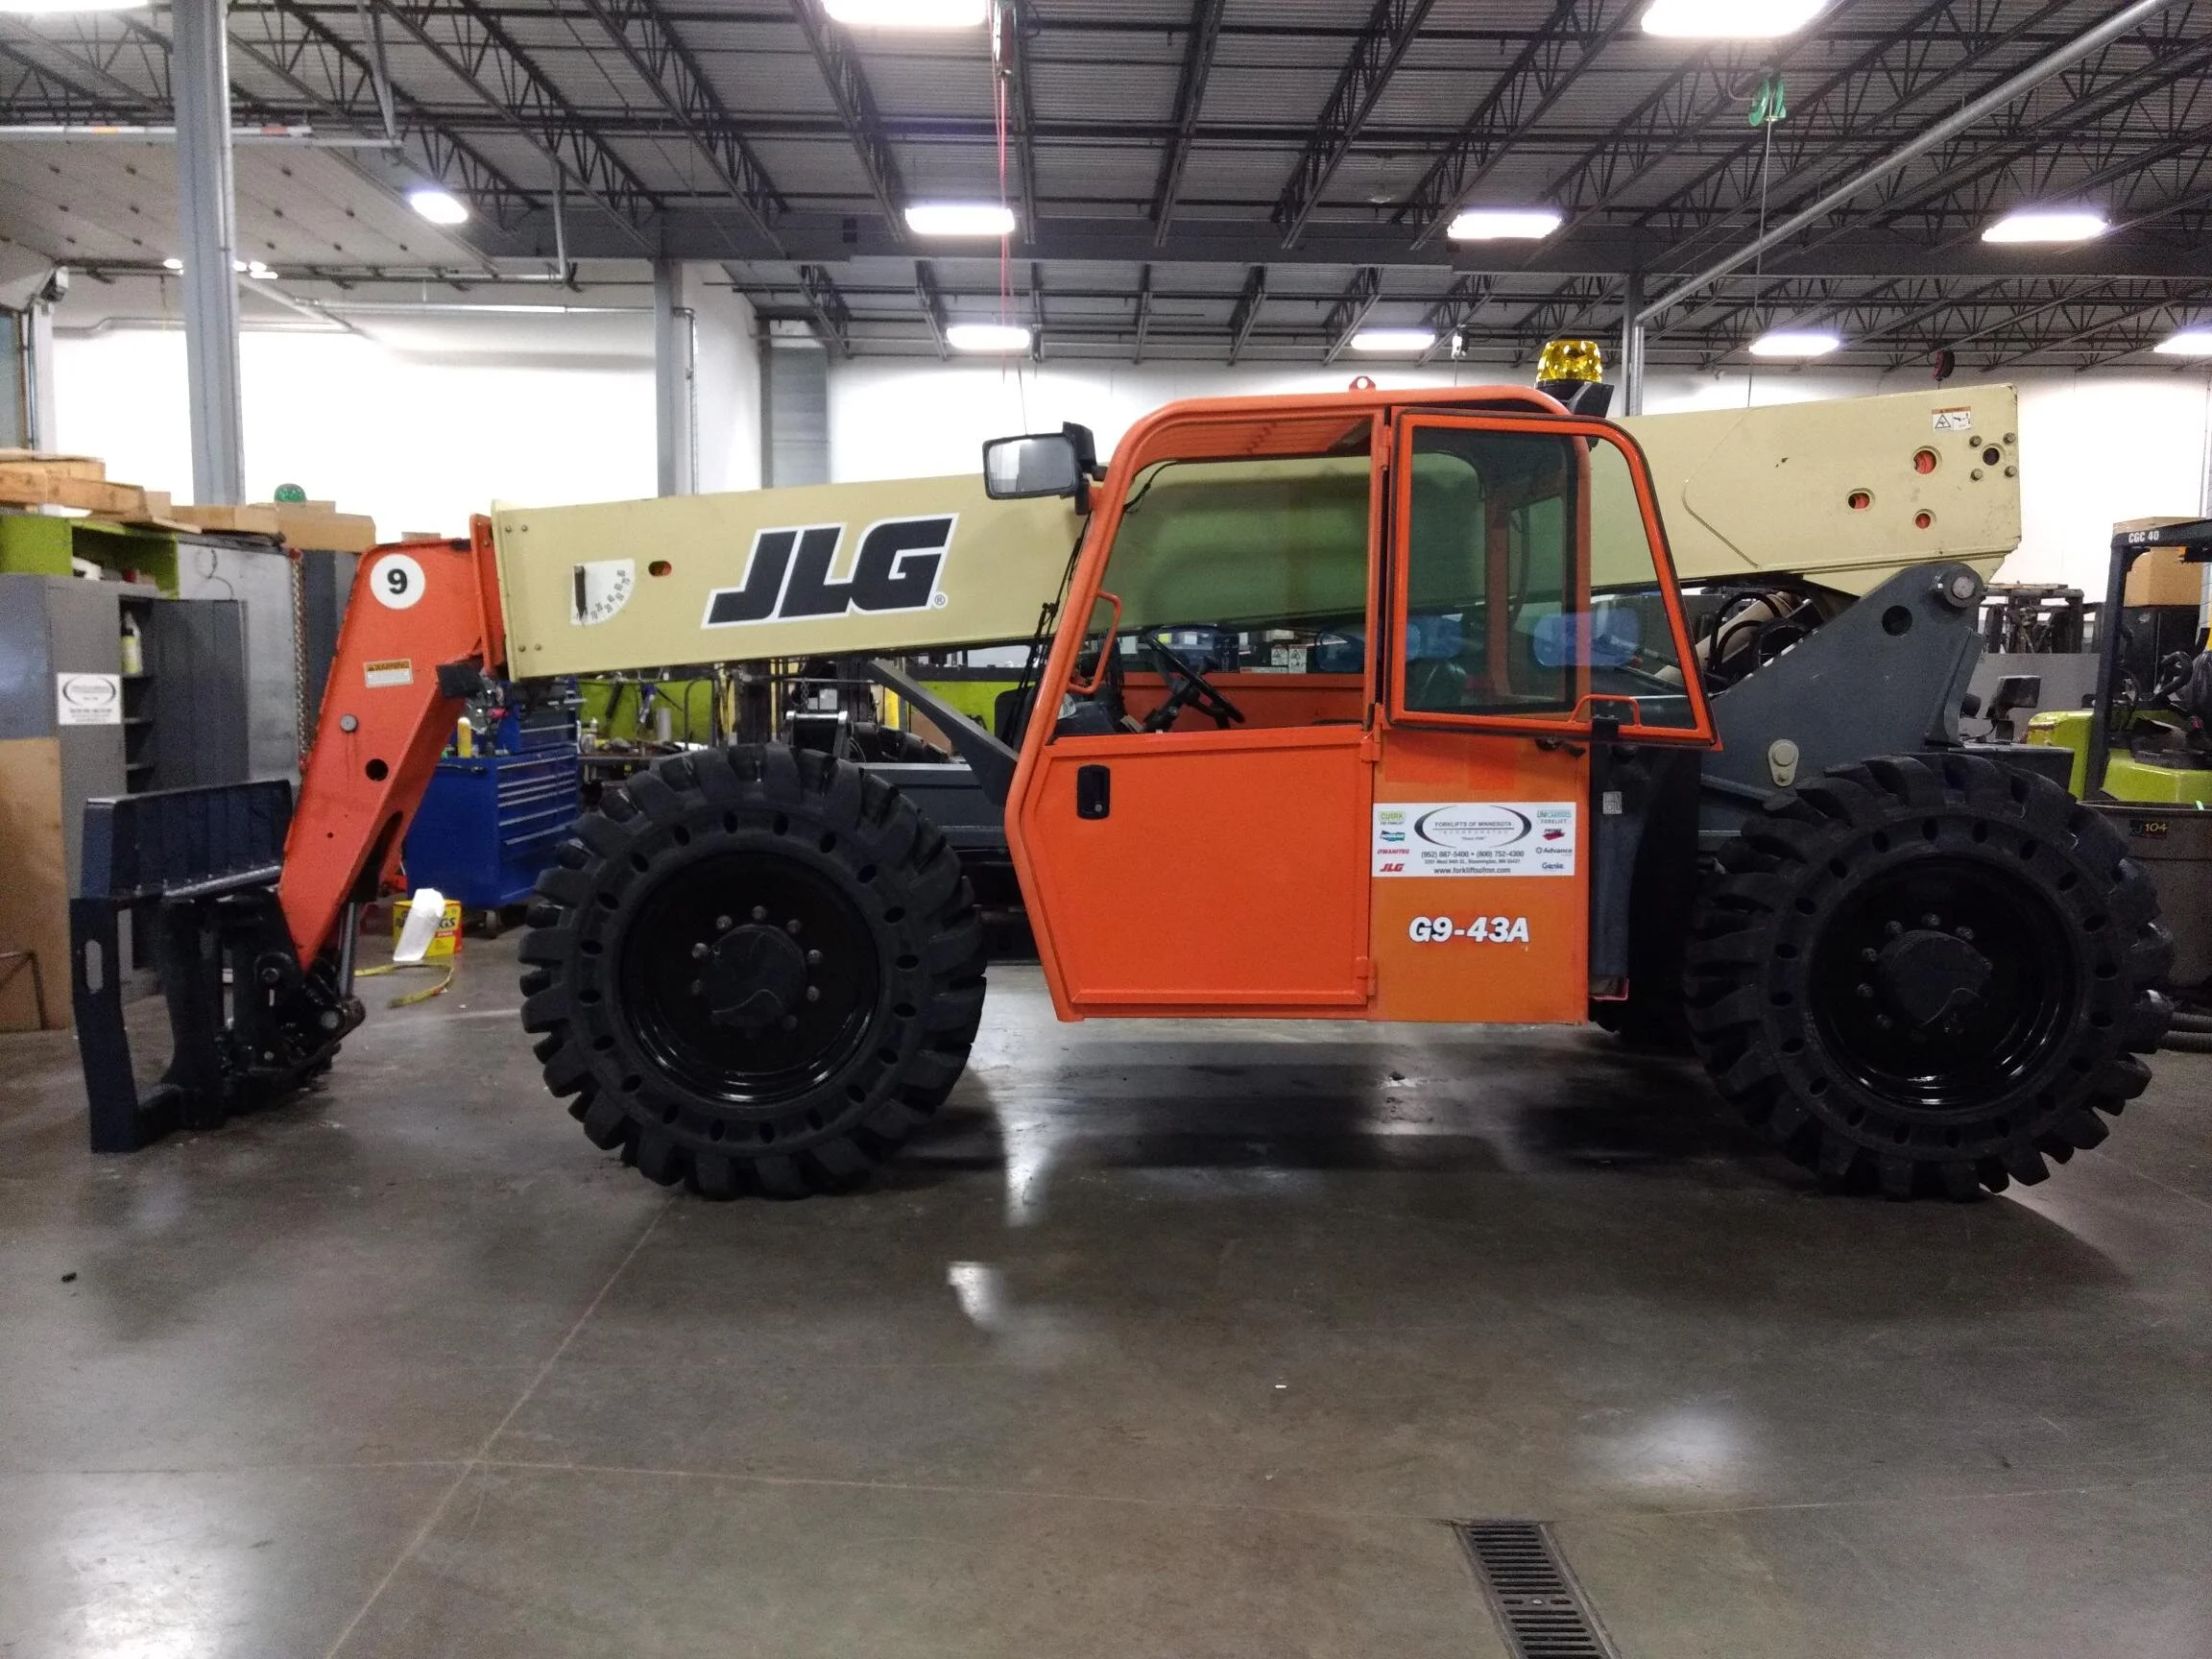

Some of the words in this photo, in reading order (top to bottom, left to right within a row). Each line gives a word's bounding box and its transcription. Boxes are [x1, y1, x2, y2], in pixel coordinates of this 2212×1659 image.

[2128, 532, 2146, 543] CGC
[2148, 530, 2160, 541] 40
[705, 515, 956, 627] JLG
[387, 568, 408, 594] 9
[2145, 823, 2167, 832] 104
[1421, 851, 1437, 859] (952)
[1380, 863, 1405, 873] JLG
[1542, 861, 1564, 870] Genie
[1408, 916, 1530, 943] G9-43A
